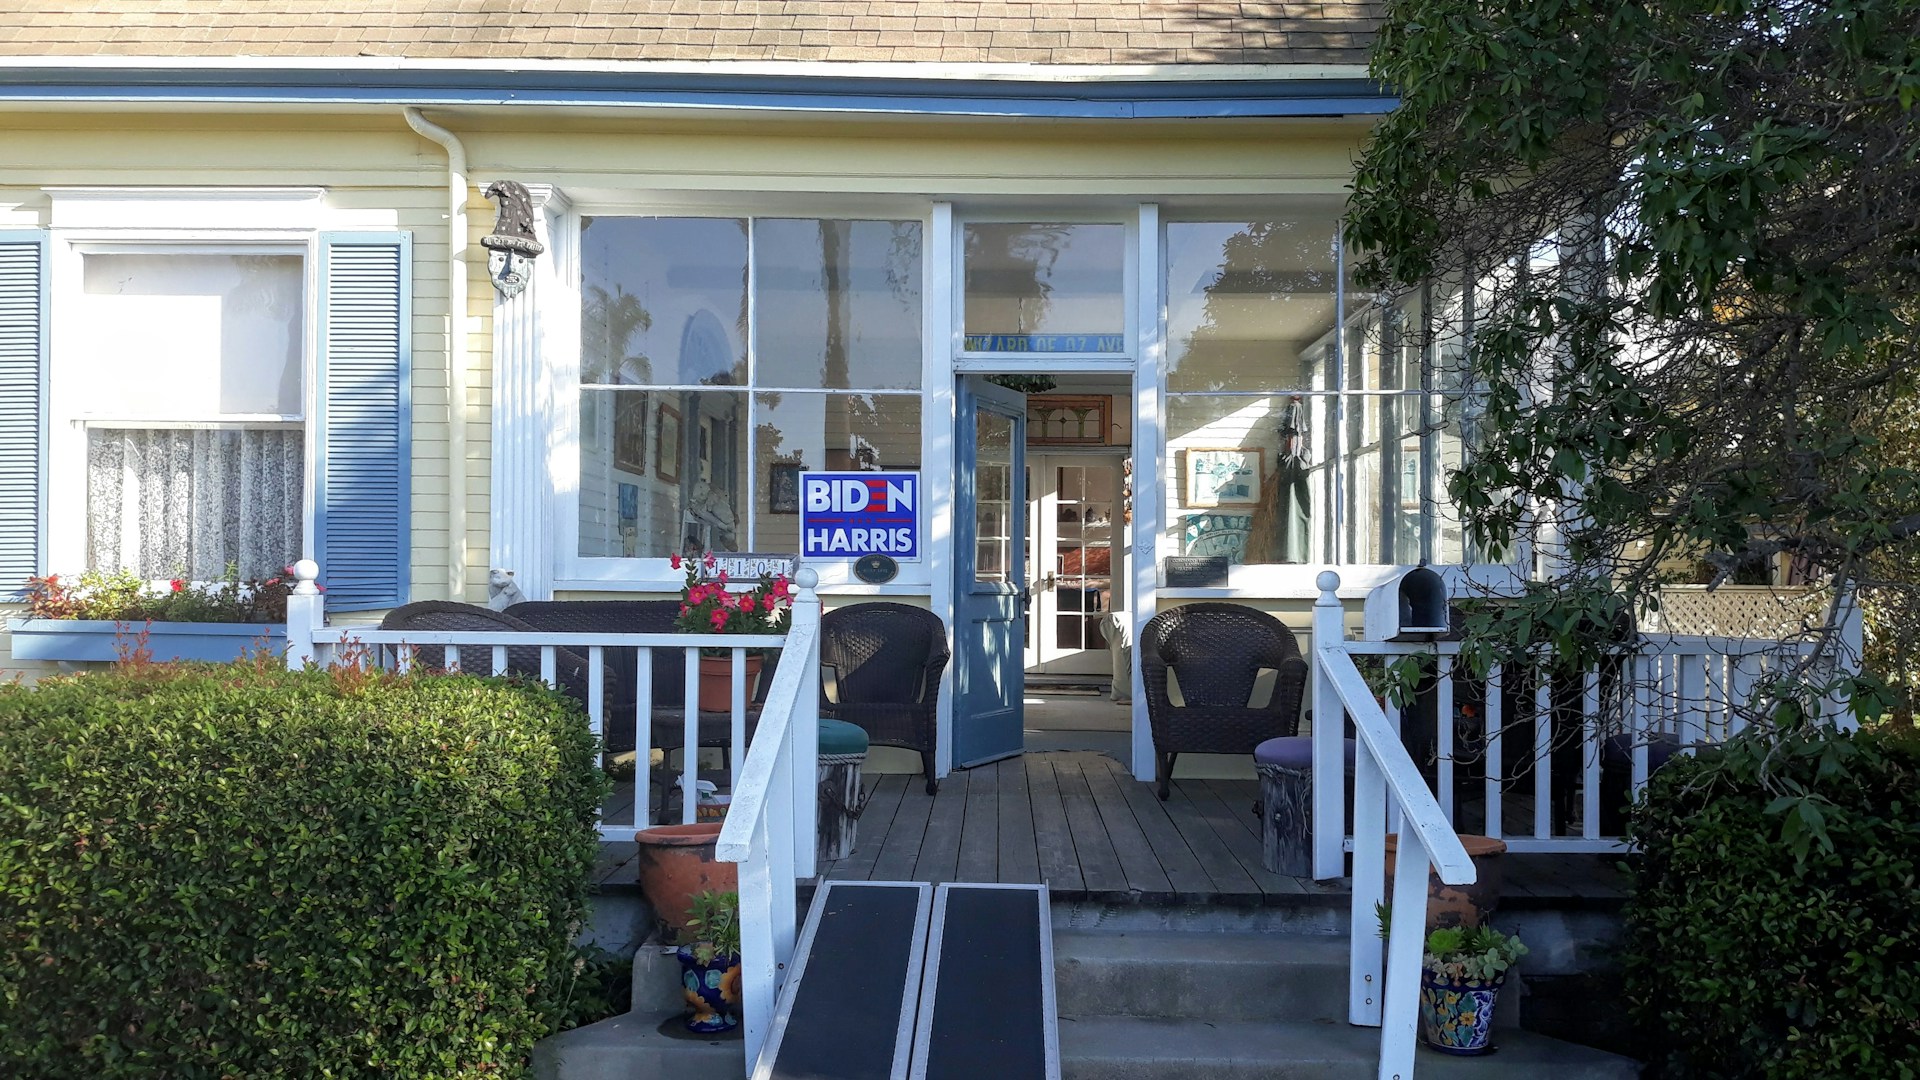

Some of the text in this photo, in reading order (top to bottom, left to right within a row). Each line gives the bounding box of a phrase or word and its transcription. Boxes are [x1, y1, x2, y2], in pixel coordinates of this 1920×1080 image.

[1037, 337, 1056, 350] OF
[1066, 337, 1086, 350] OZ
[807, 480, 912, 512] BIDEN
[807, 528, 912, 552] HARRIS
[714, 561, 785, 575] 1101
